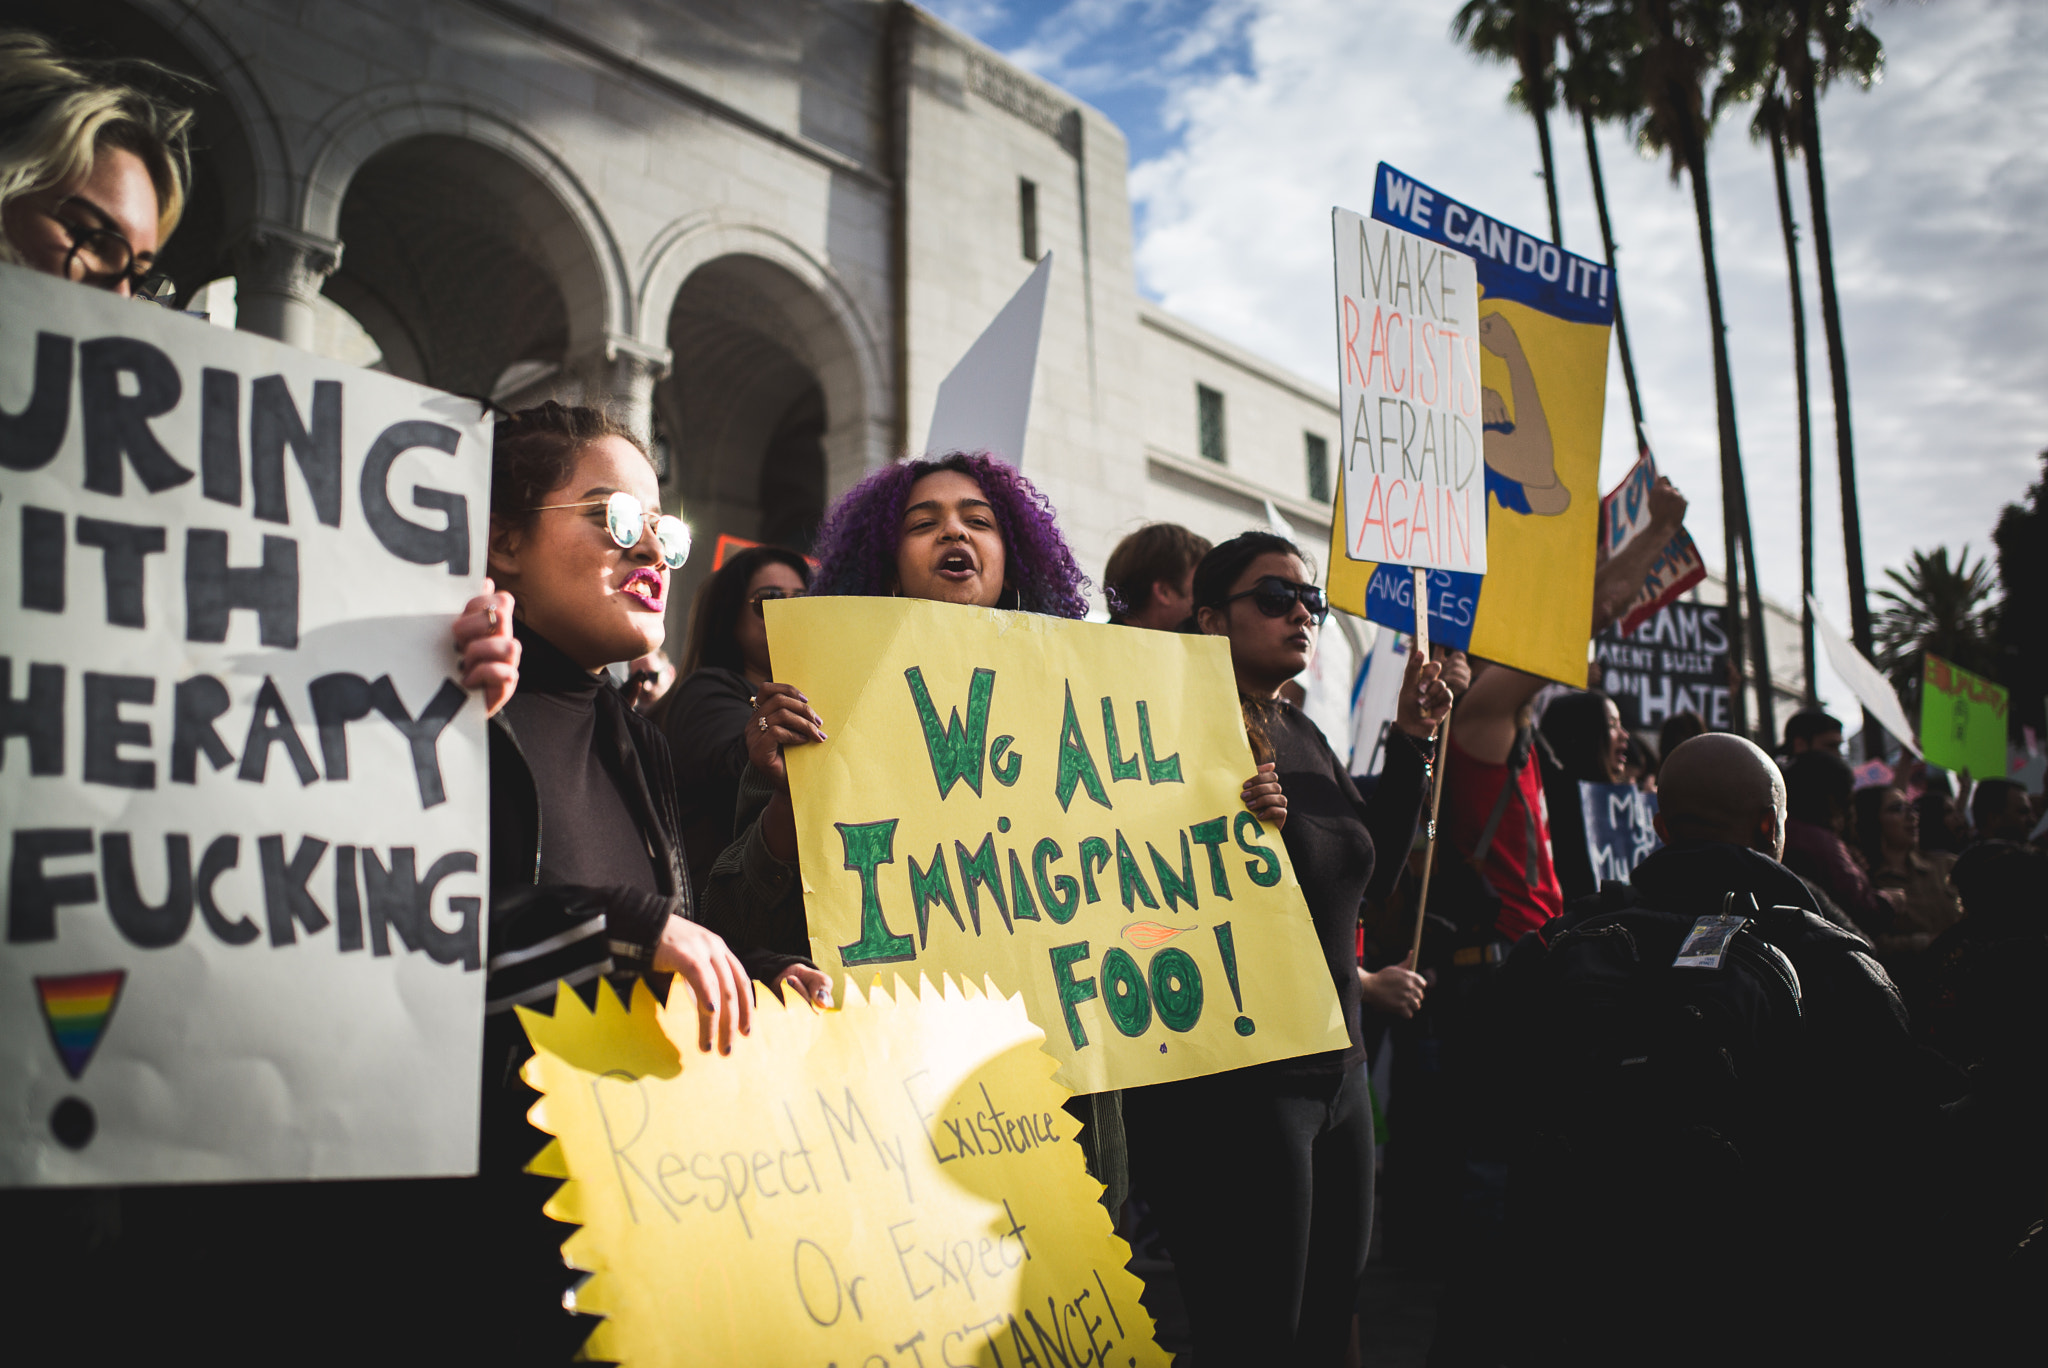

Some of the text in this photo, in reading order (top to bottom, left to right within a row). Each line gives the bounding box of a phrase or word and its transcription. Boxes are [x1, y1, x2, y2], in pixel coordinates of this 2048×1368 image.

[1359, 219, 1459, 326] MAKE
[1386, 170, 1434, 230] WE
[1443, 203, 1511, 265] CAN
[1566, 257, 1609, 307] IT!
[1343, 295, 1478, 417] RACISTS
[1349, 394, 1477, 492] AFRAID
[0, 494, 300, 650] ITH
[1356, 474, 1471, 567] AGAIN
[1368, 570, 1473, 627] ANGLES
[1600, 605, 1728, 654] EAMS
[904, 666, 1185, 813] We ALL
[1641, 674, 1731, 729] HATE
[7, 828, 483, 972] FUCKING
[1048, 921, 1256, 1051] FOO!
[591, 1069, 1060, 1239] Respect My Existence
[793, 1198, 1032, 1327] Or Expect
